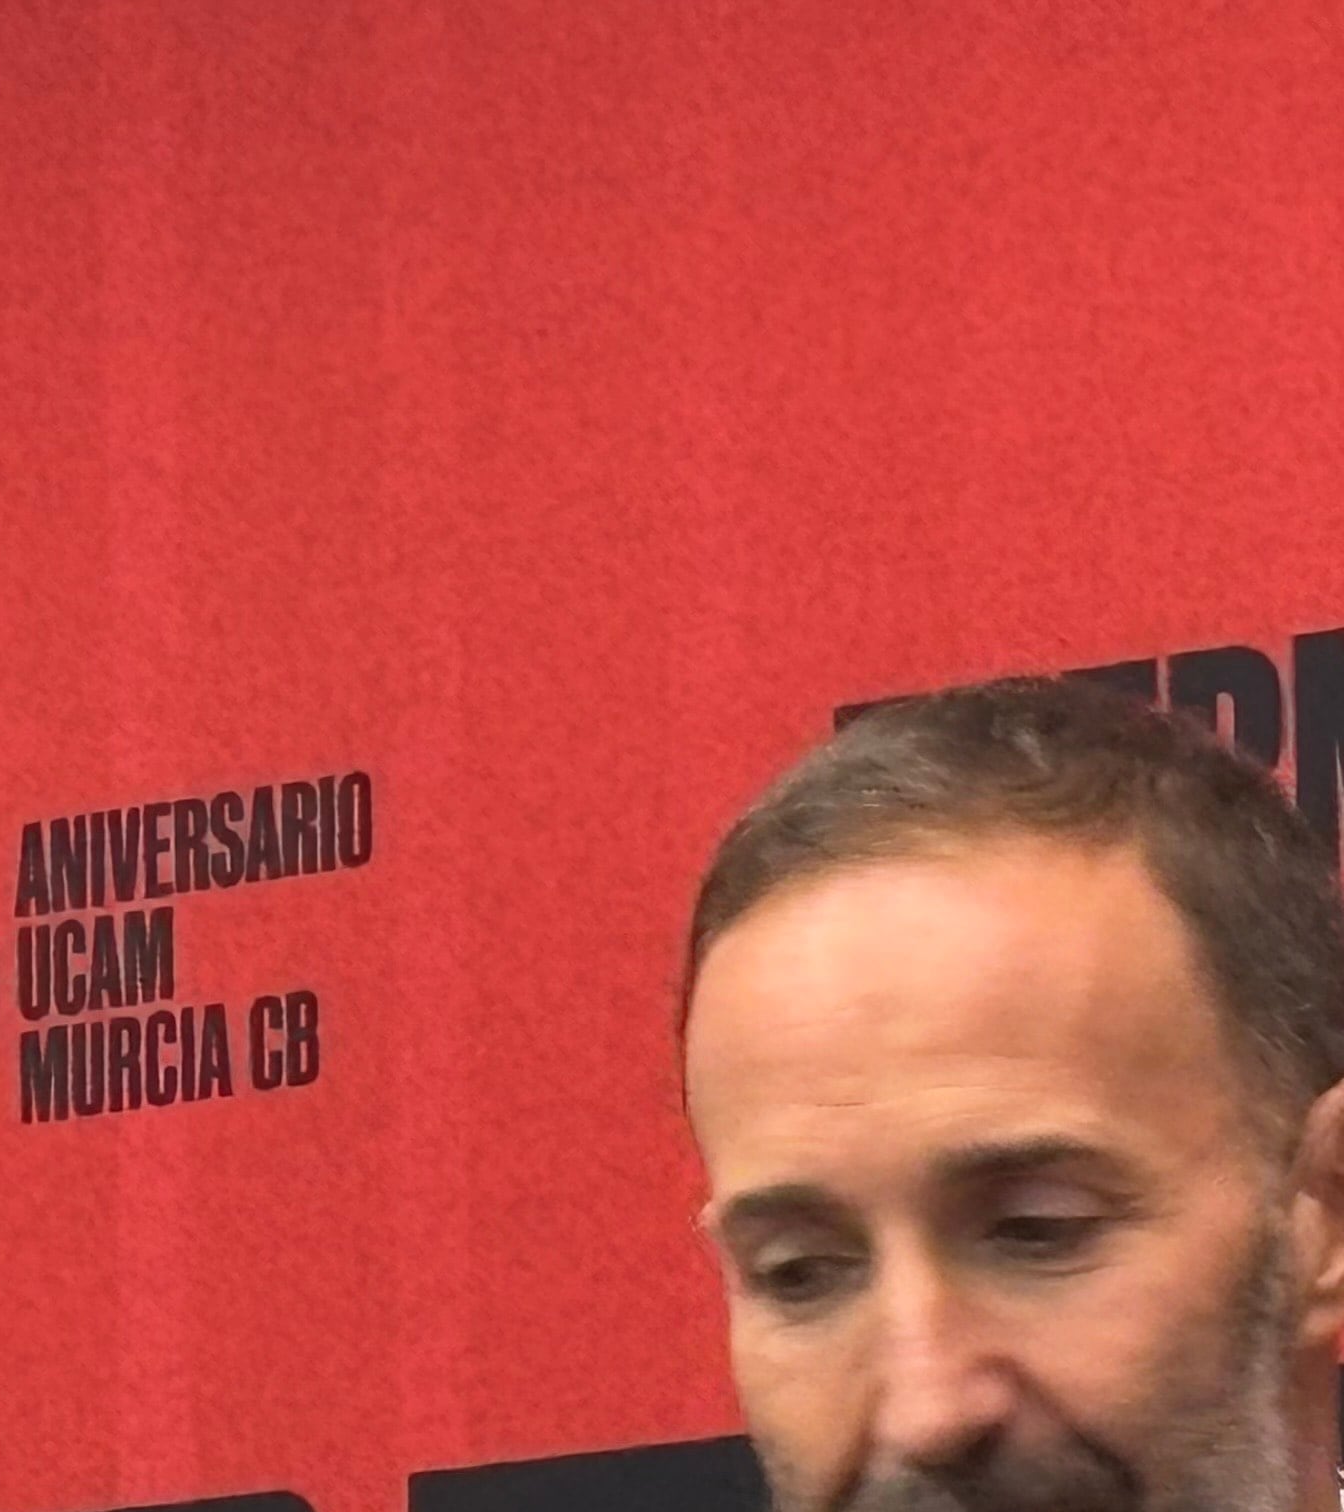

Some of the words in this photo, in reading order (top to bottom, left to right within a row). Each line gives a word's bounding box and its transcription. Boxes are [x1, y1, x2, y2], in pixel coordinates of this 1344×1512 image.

[15, 771, 372, 917] ANIVERSARIO
[17, 906, 175, 1021] UCAM
[20, 1002, 232, 1125] MURCIA
[248, 991, 320, 1090] CB
